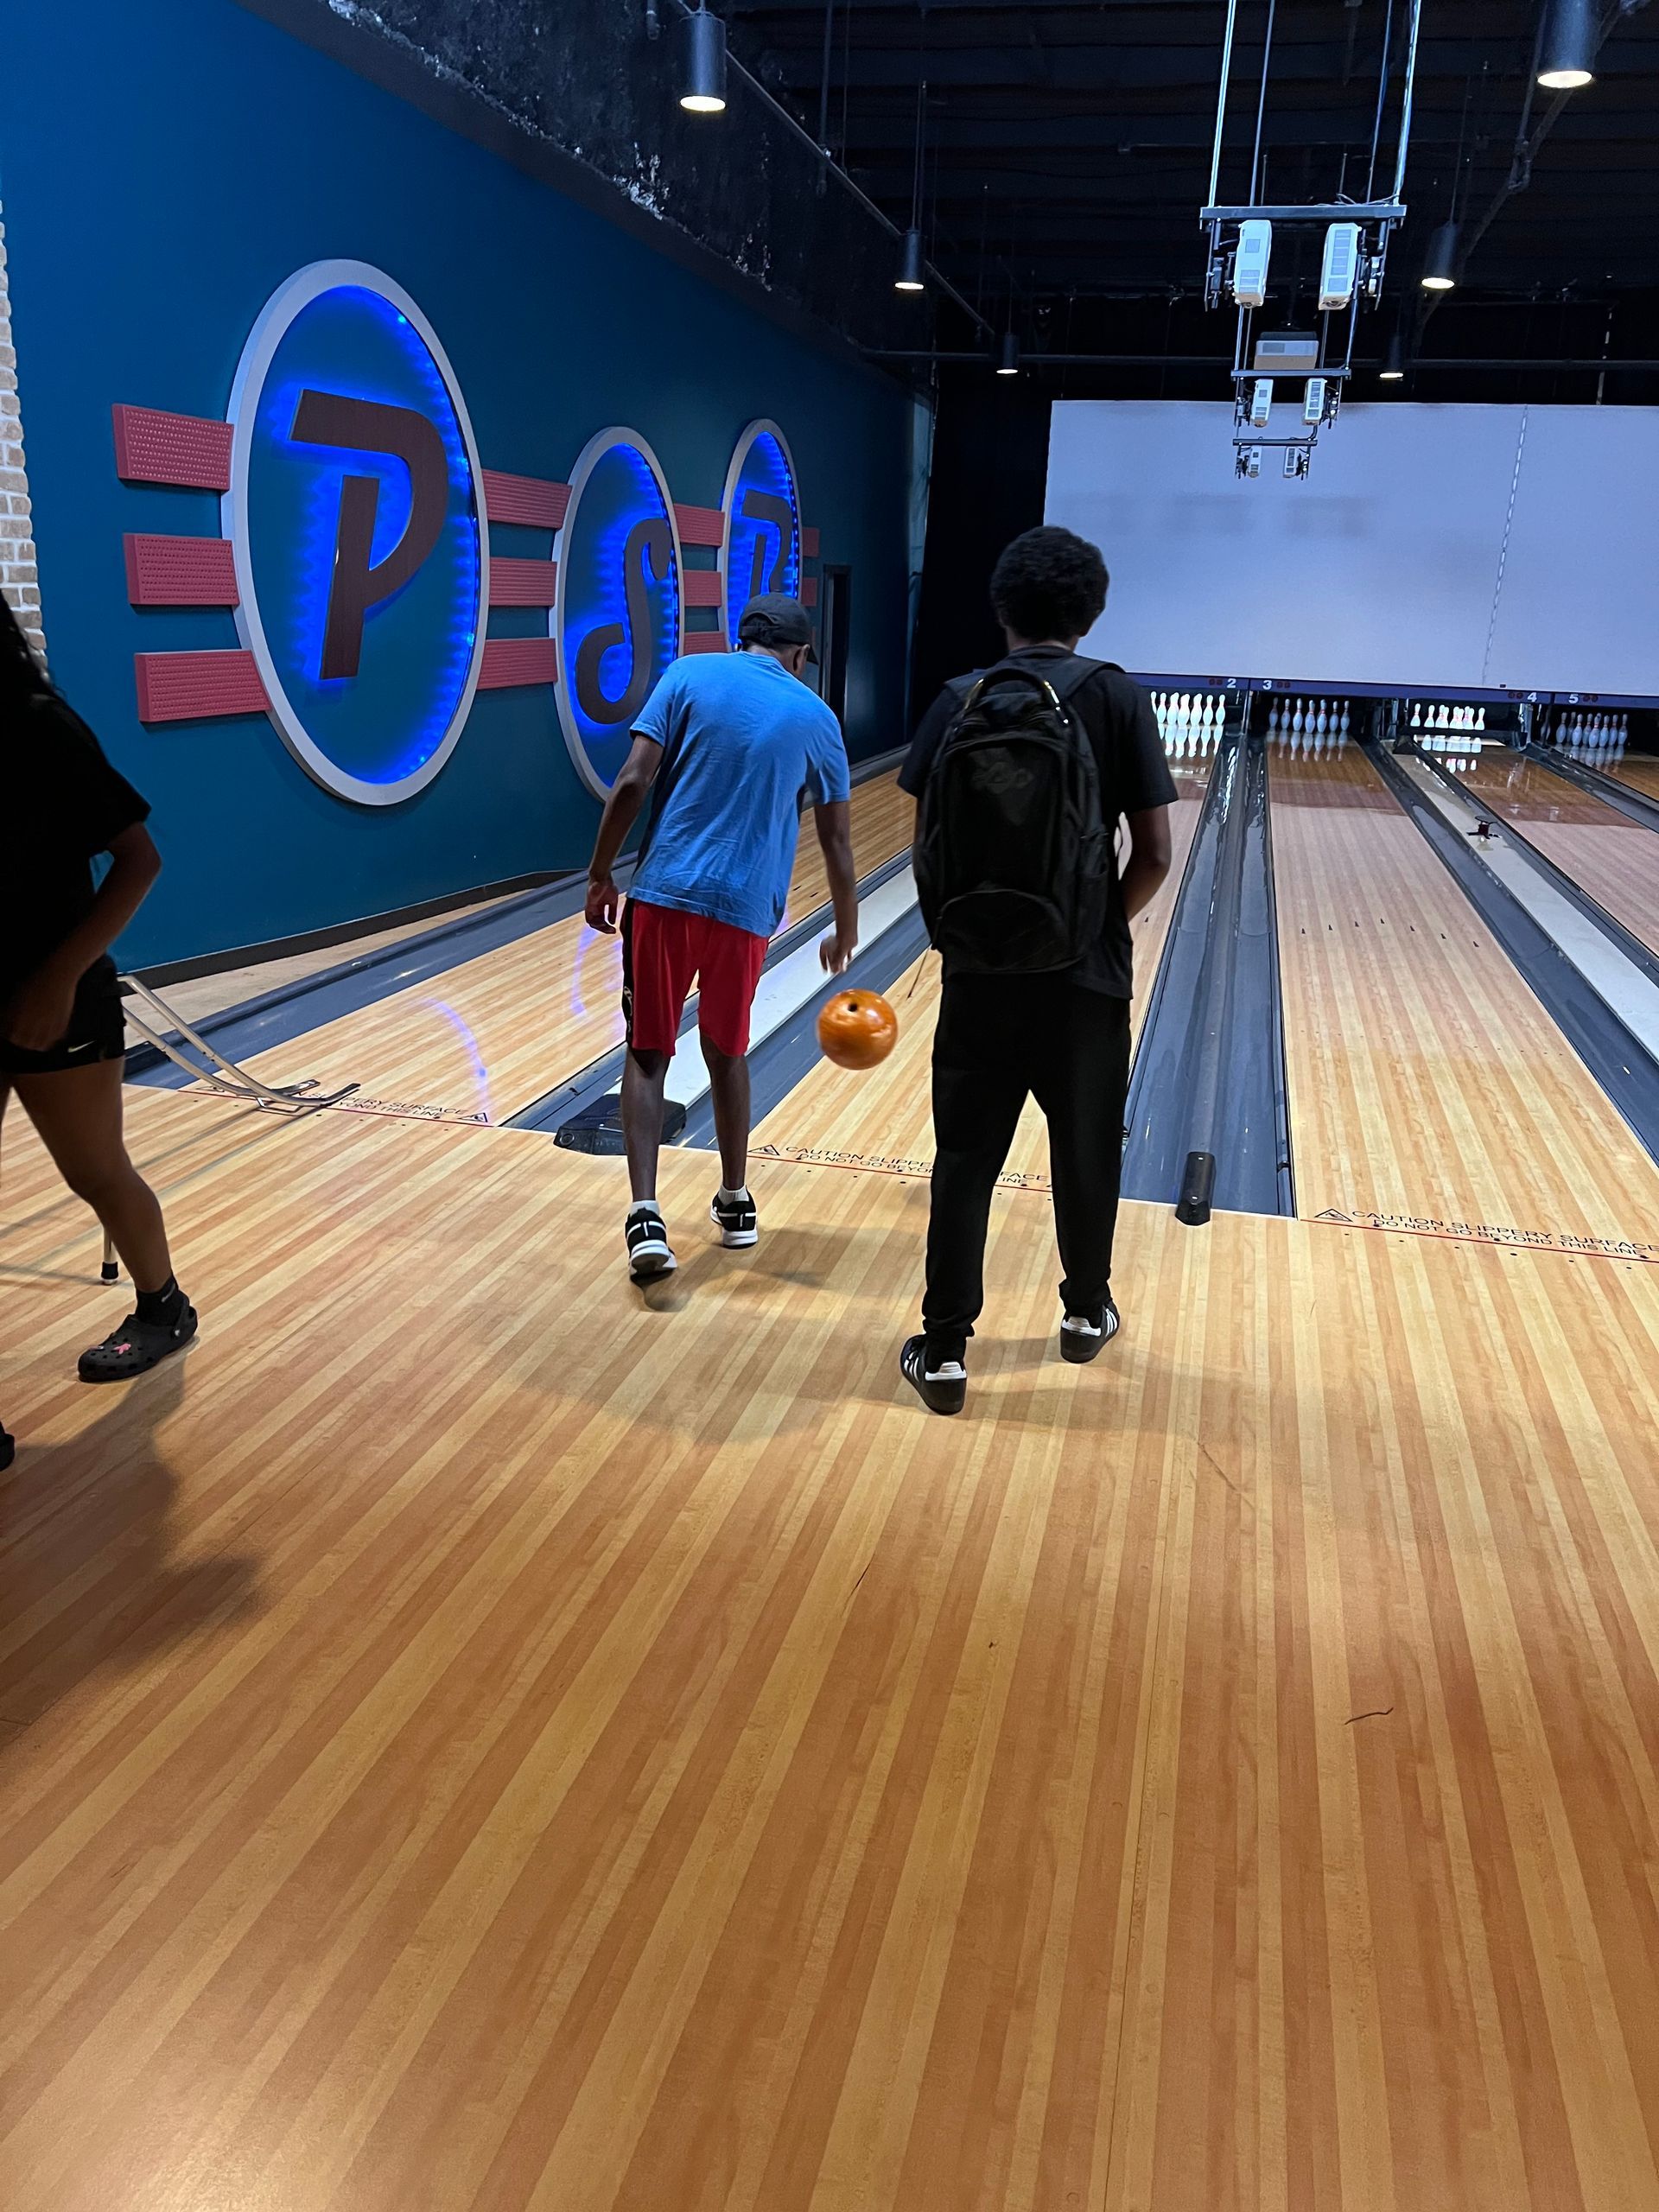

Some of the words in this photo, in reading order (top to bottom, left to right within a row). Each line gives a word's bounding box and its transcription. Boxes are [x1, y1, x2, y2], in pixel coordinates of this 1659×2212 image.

[289, 389, 449, 680] P
[576, 518, 670, 725] S
[1227, 678, 1236, 688] 2
[1262, 680, 1272, 690] 3
[1527, 692, 1537, 702] 4
[1568, 694, 1579, 703] 5
[389, 1103, 467, 1115] SURFACE
[785, 1146, 864, 1160] CAUTION
[870, 1155, 931, 1168] SLIPPE
[824, 1156, 854, 1165] NOT
[887, 1164, 933, 1173] BEYO
[1351, 1211, 1444, 1227] CAUTION
[1452, 1222, 1553, 1239] SLIPPERY
[1560, 1235, 1659, 1251] SURFACE
[1404, 1223, 1439, 1231] NOT
[1478, 1231, 1553, 1245] BEYOND
[1558, 1241, 1599, 1250] THIS
[1604, 1246, 1643, 1255] LINE
